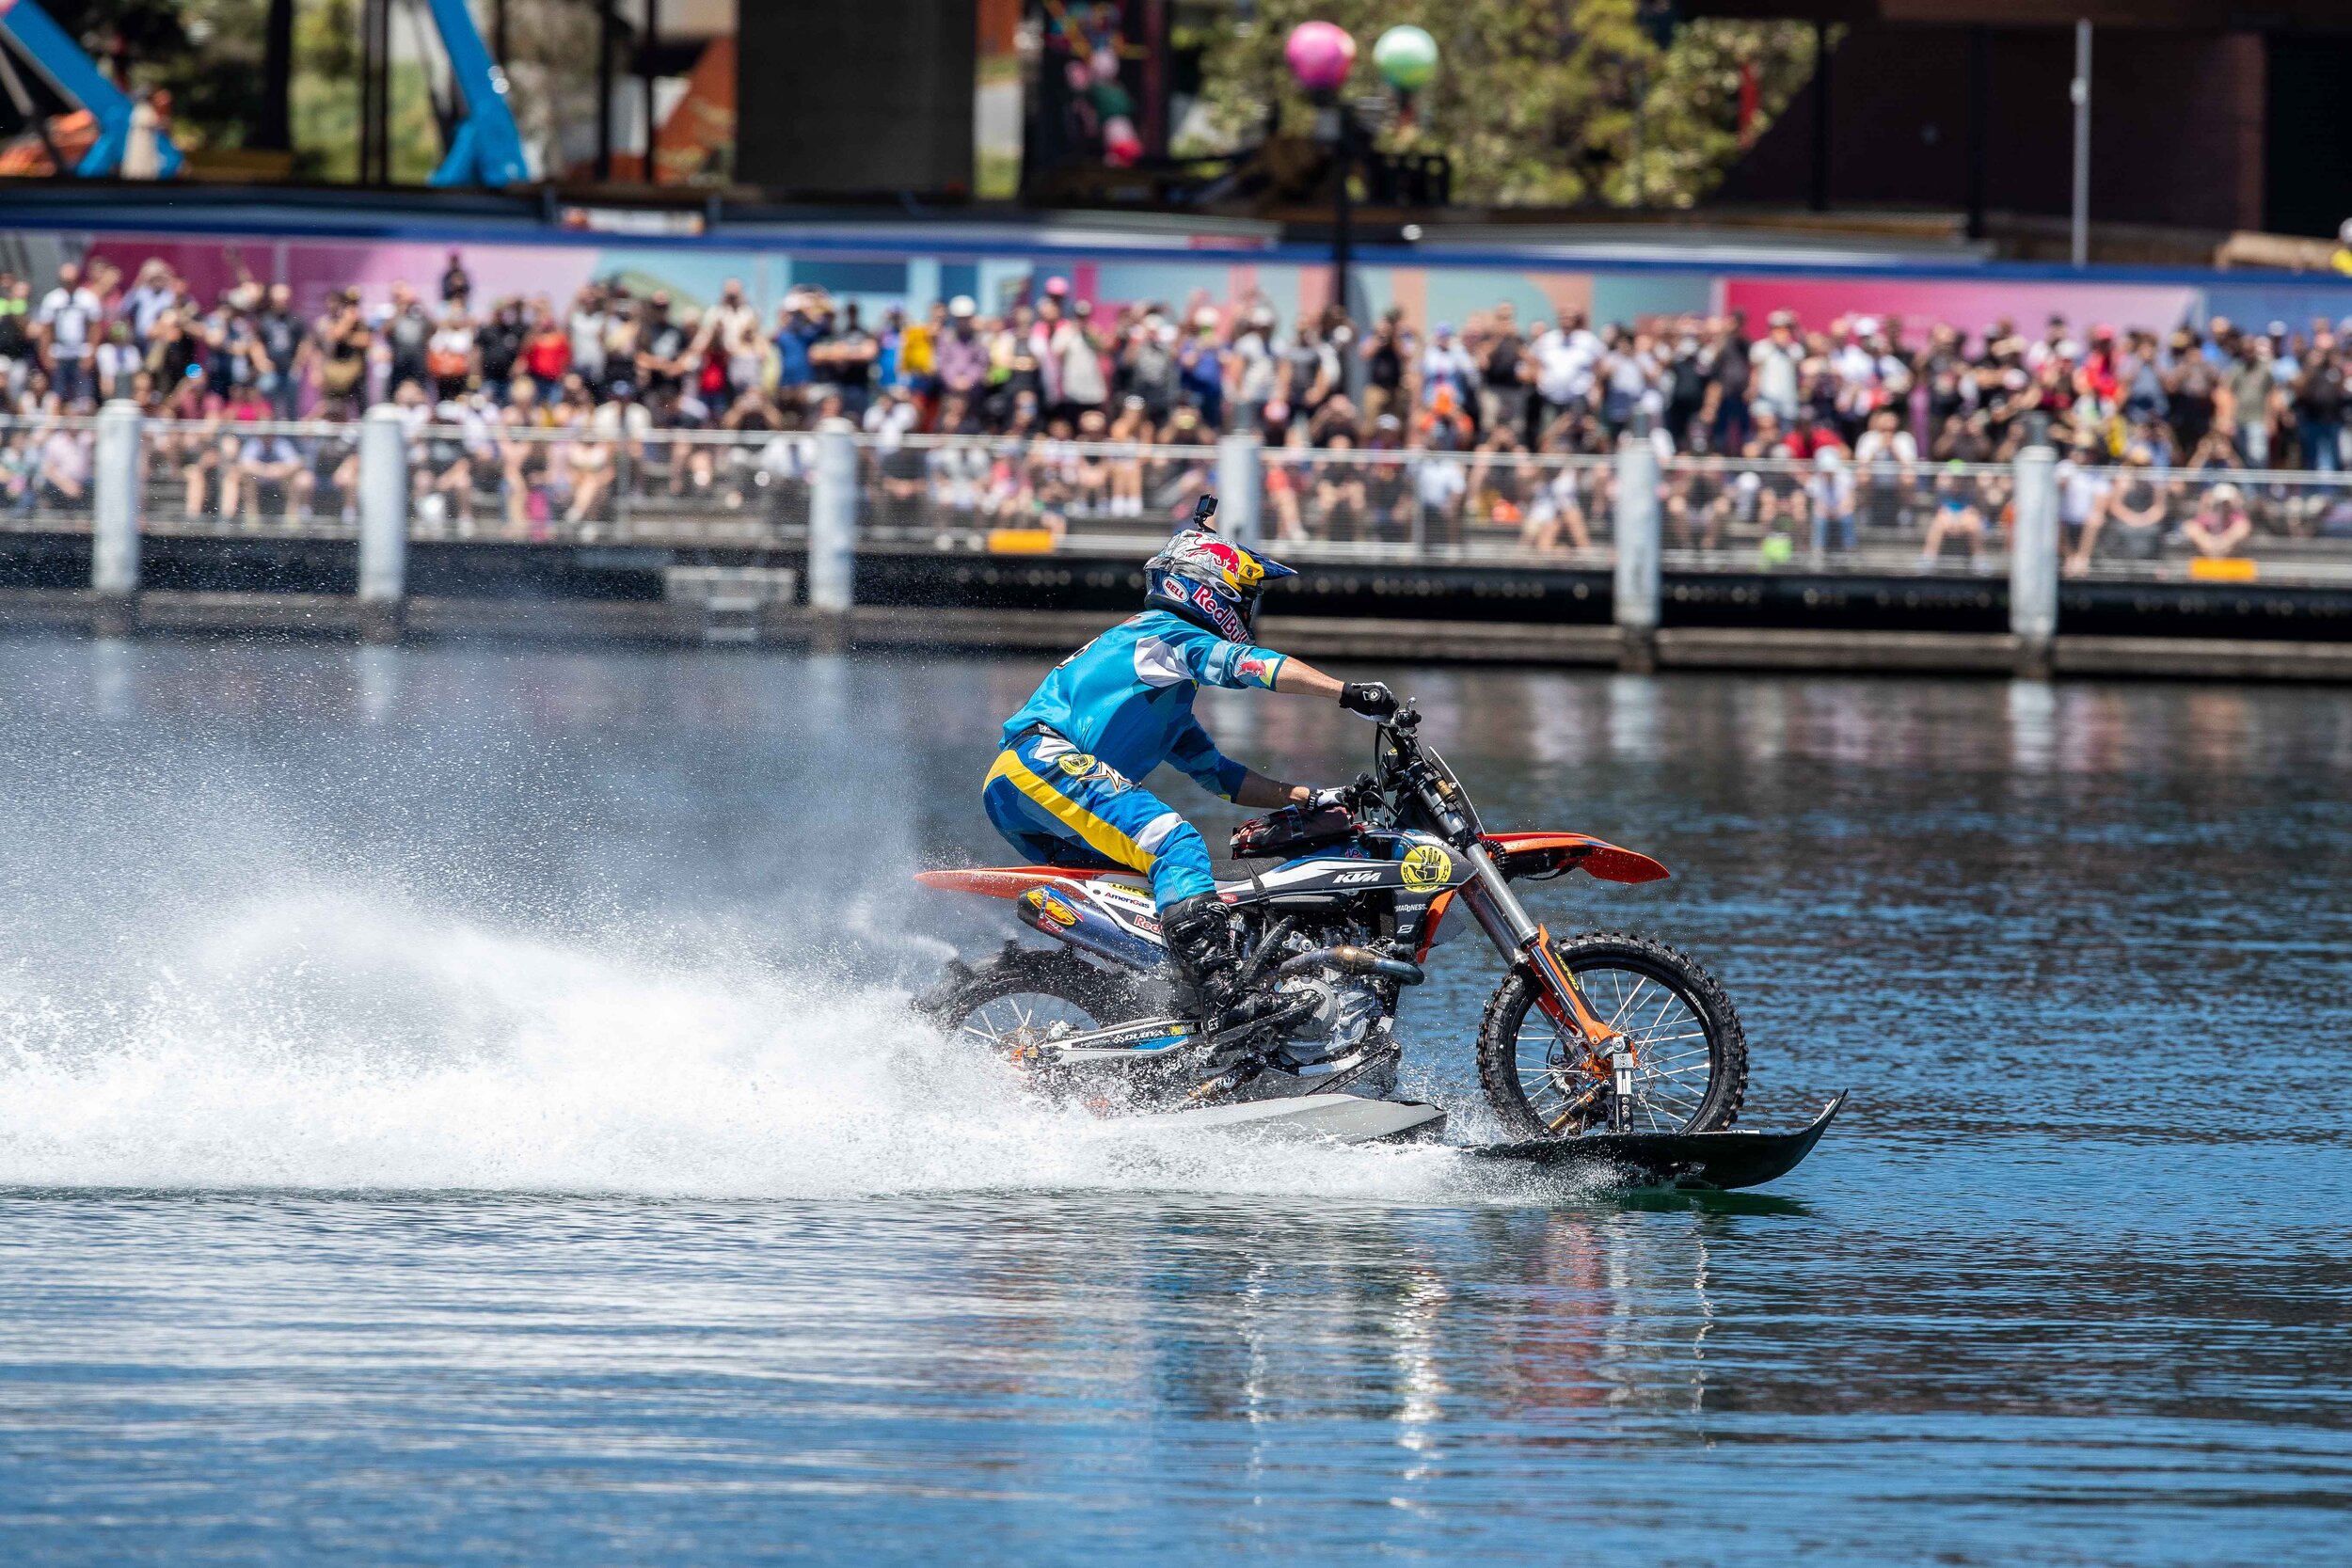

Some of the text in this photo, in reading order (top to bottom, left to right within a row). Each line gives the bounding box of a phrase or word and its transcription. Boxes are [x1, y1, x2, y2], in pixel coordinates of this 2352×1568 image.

[1165, 579, 1184, 600] BELL
[1332, 869, 1382, 884] KTM
[1104, 892, 1151, 910] AmeriGas
